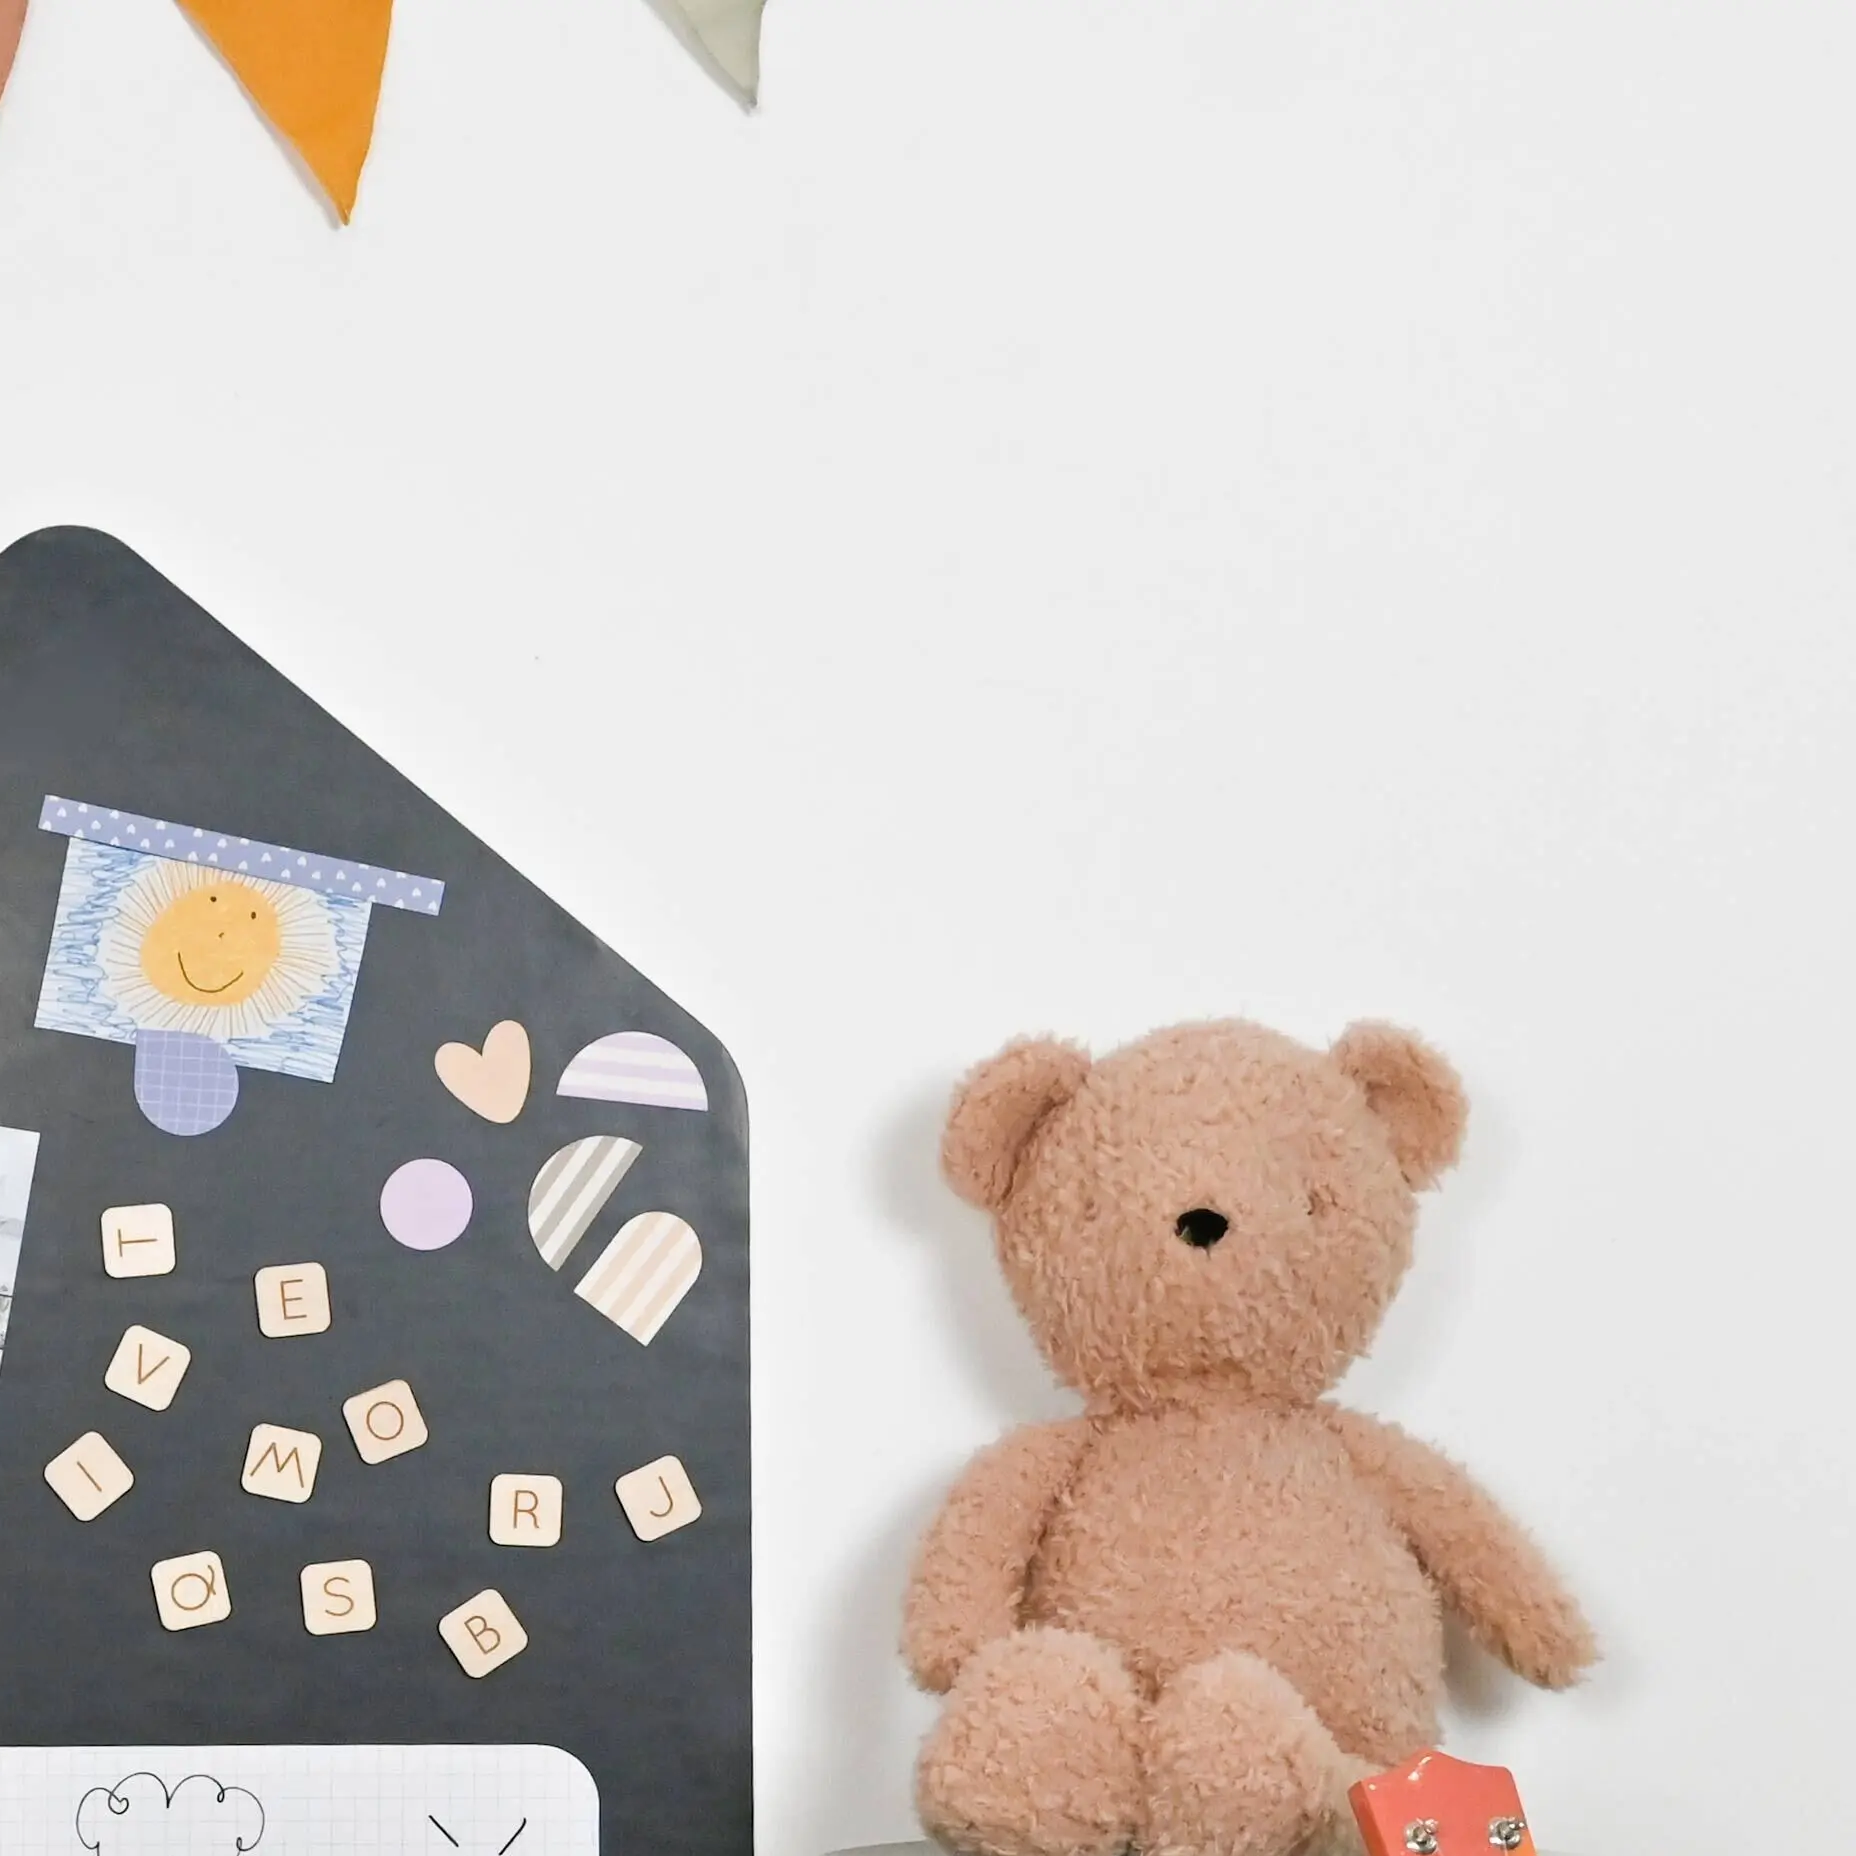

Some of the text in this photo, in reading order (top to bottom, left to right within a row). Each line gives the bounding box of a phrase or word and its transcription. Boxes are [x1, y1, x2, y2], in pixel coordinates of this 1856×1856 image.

[117, 1228, 158, 1258] T
[279, 1278, 308, 1321] E
[136, 1343, 171, 1386] V
[249, 1441, 305, 1489] M
[513, 1489, 540, 1529] R
[649, 1475, 674, 1518] J
[323, 1576, 355, 1617] S
[463, 1615, 502, 1656] B
